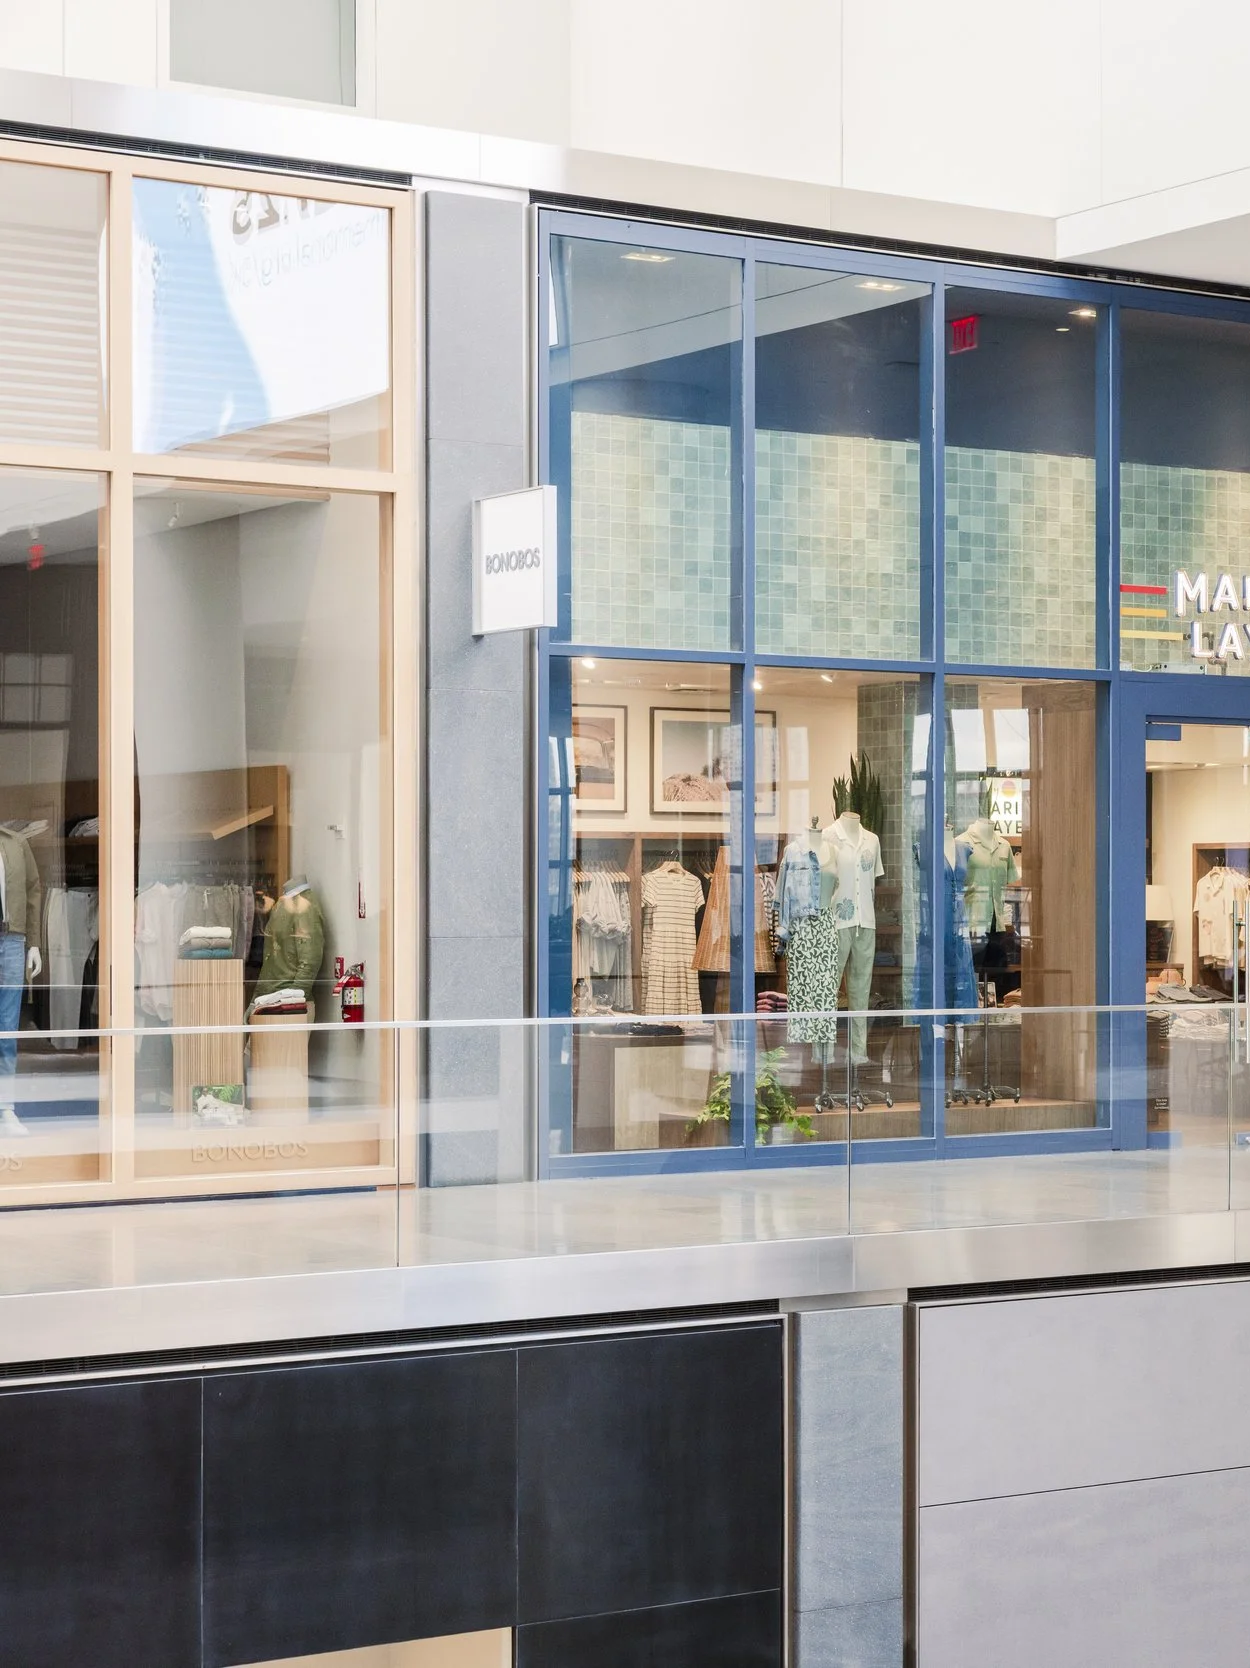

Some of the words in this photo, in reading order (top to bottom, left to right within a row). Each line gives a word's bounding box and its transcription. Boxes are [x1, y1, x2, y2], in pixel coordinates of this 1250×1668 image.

[485, 547, 541, 575] BONOBOS
[991, 801, 1019, 815] ARI
[993, 820, 1022, 834] AYE
[190, 1140, 309, 1164] BONOBOS
